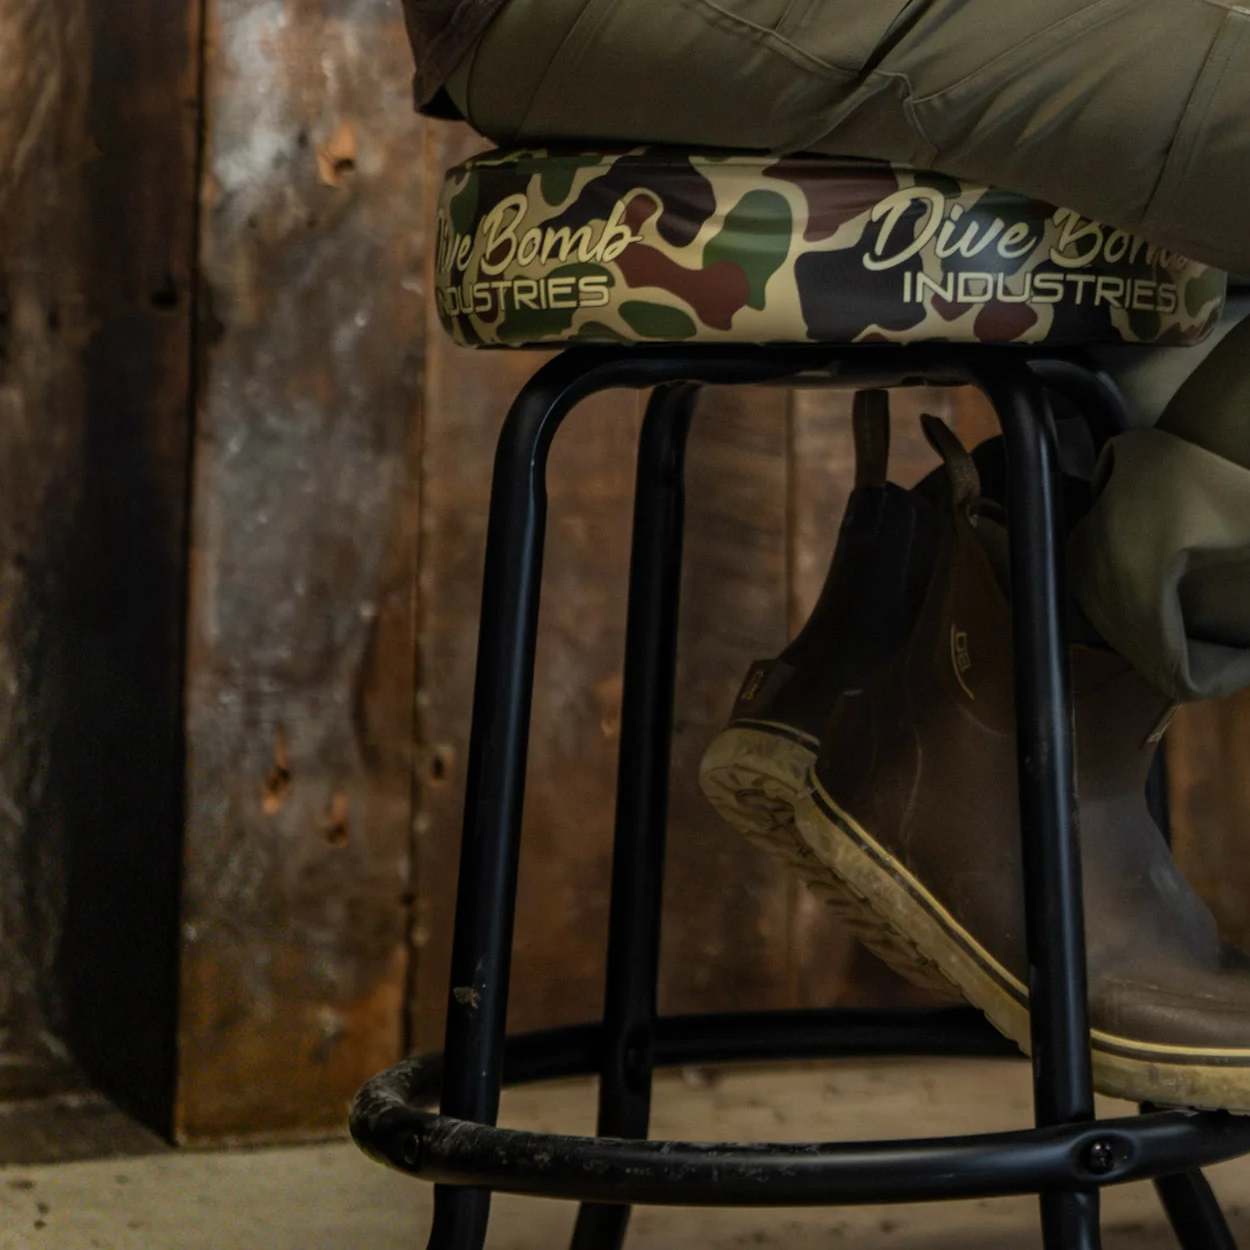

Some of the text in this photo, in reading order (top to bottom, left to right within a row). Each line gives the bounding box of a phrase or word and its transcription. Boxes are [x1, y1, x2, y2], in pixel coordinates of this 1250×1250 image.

[480, 192, 644, 276] Bomb
[862, 186, 1038, 272] Dive
[902, 270, 1178, 314] INDUSTRIES
